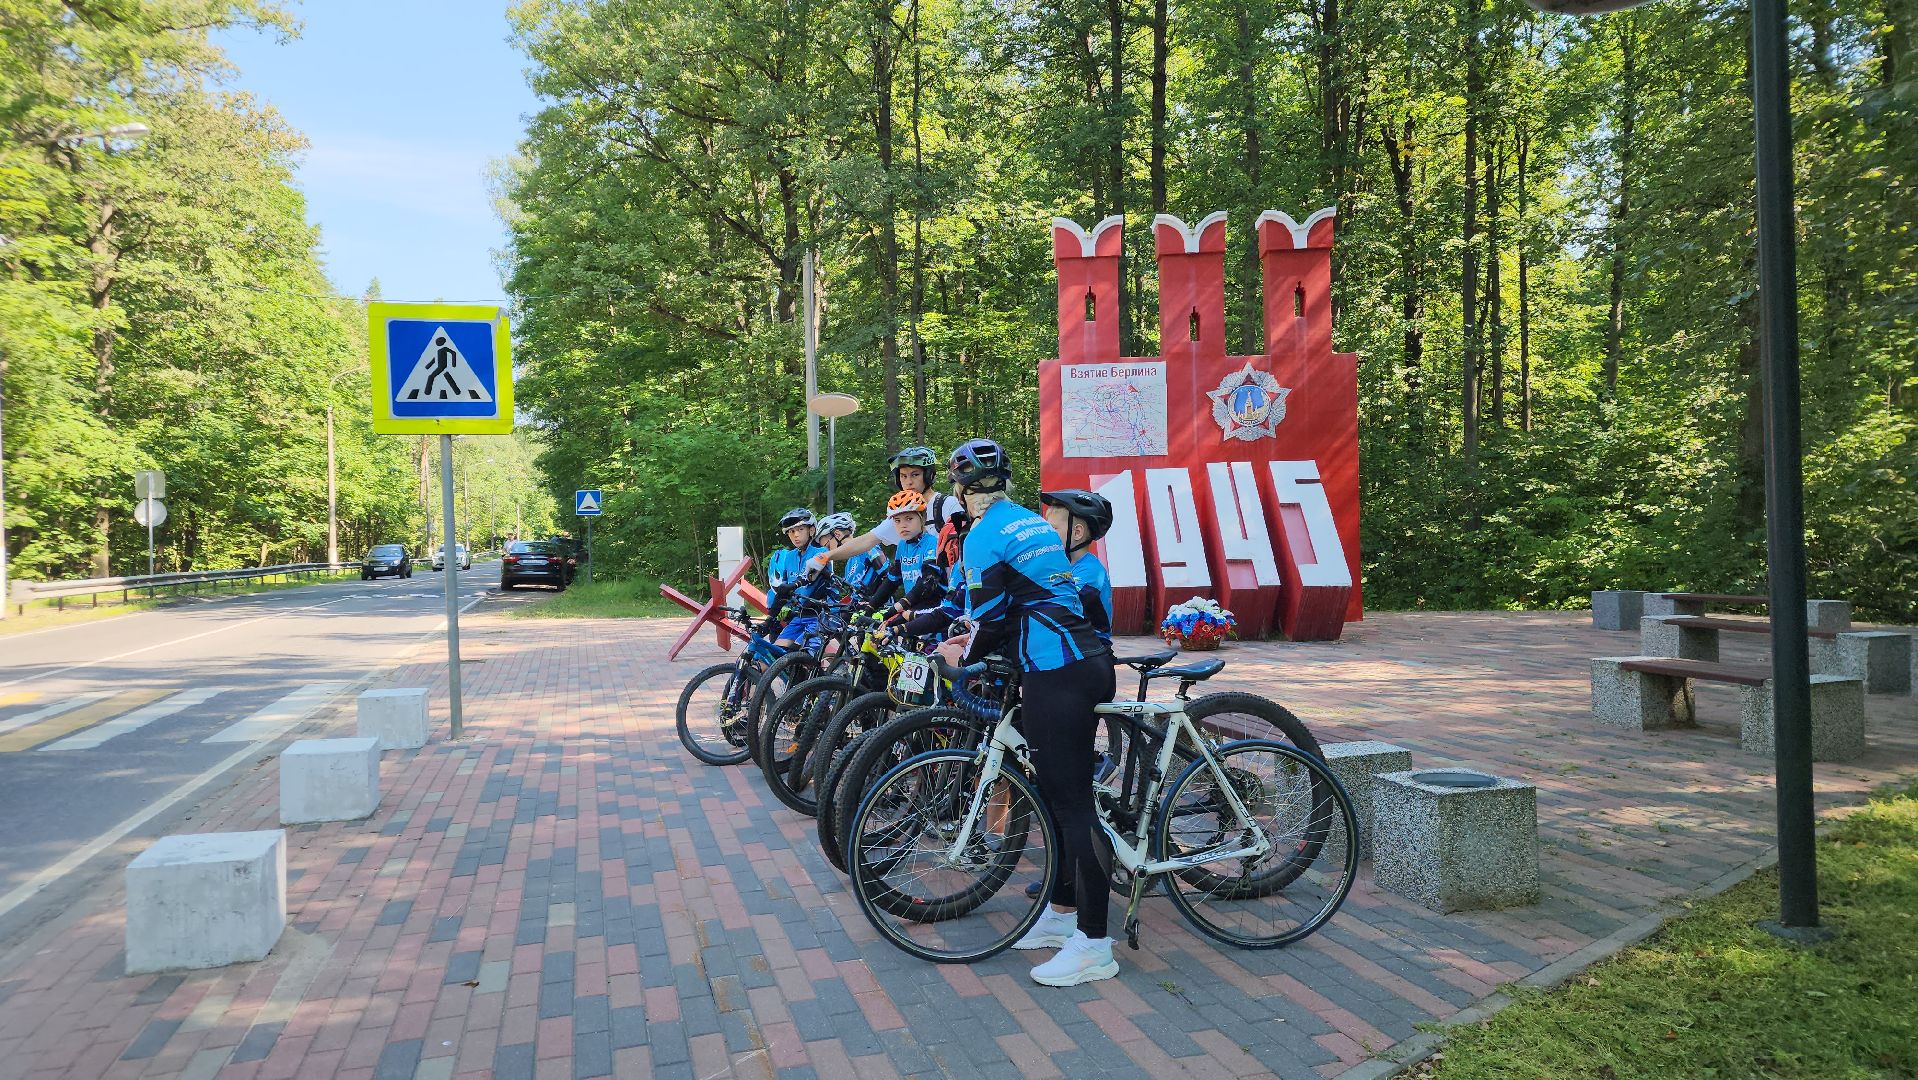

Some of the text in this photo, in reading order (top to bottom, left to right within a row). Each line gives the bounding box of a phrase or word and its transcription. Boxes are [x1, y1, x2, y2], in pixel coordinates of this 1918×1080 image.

[1070, 366, 1157, 379] Взятие Берлина
[1090, 459, 1353, 590] 1945
